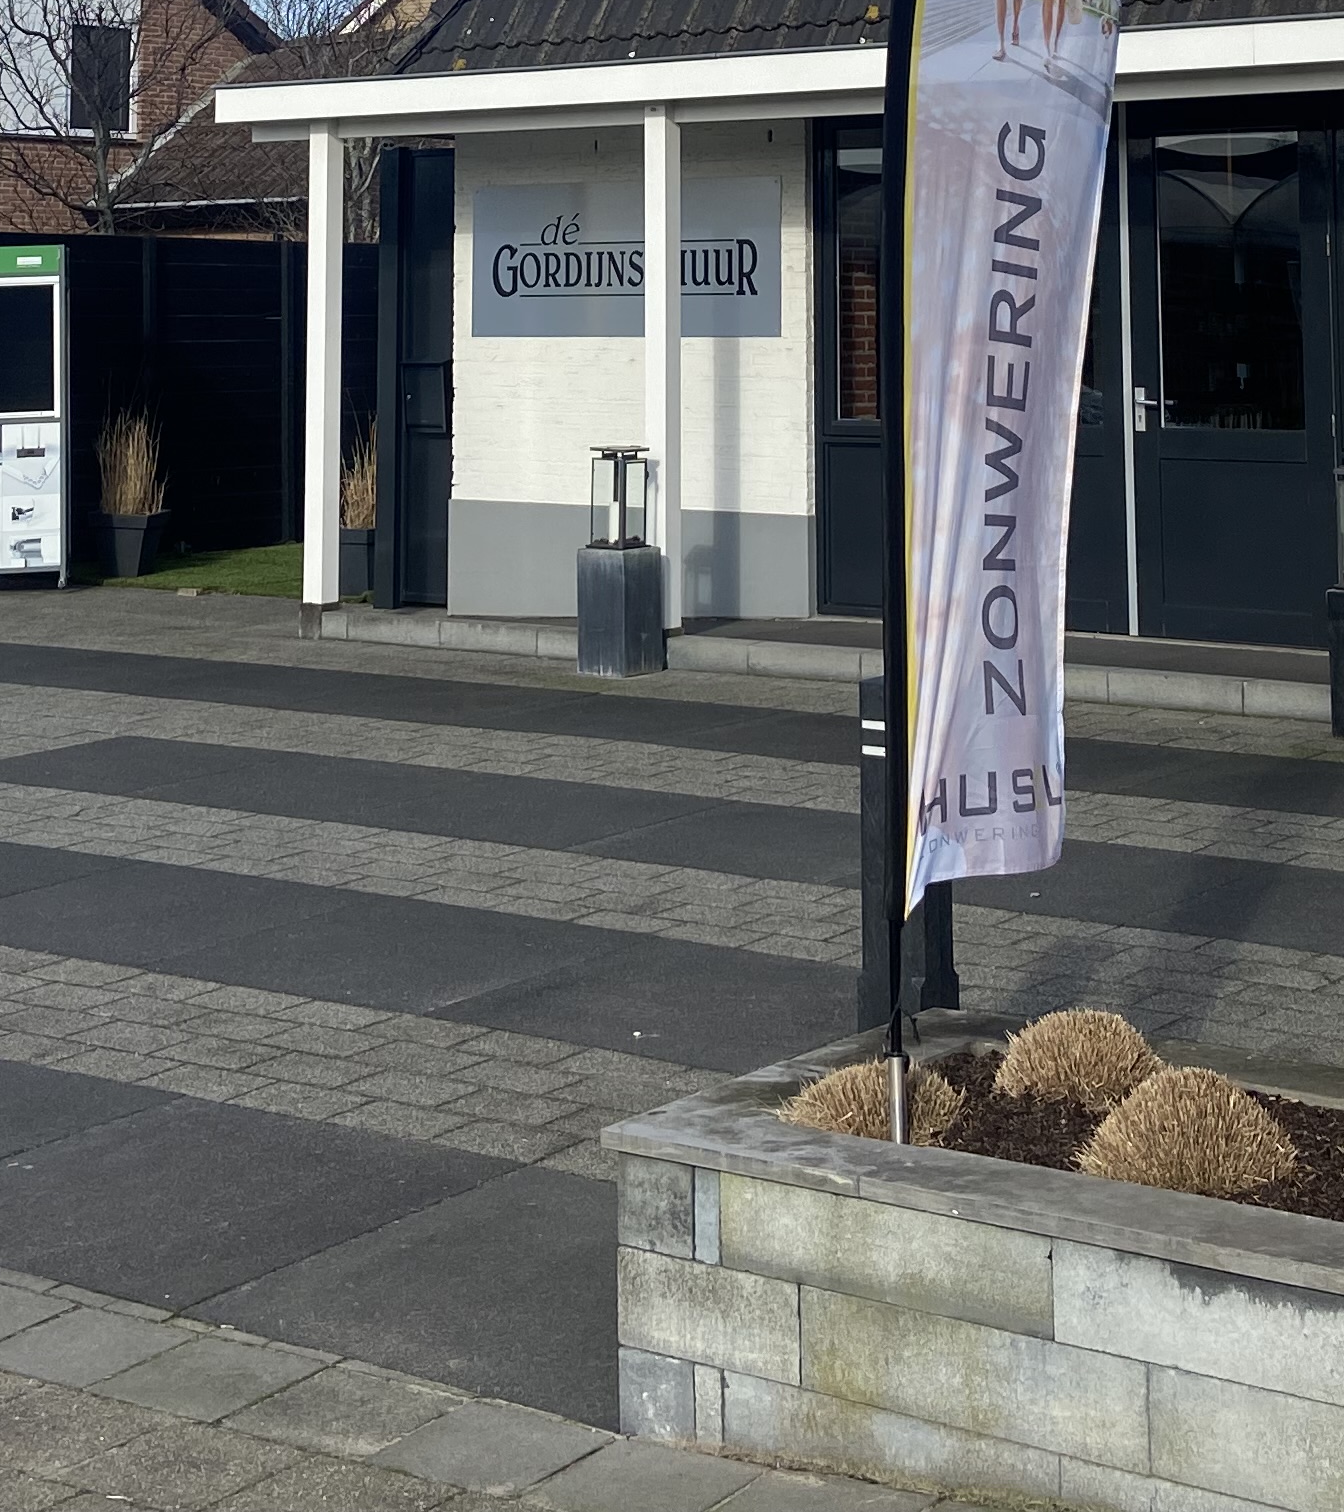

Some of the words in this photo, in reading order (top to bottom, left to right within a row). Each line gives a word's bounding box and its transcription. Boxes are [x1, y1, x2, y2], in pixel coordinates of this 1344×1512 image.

[540, 212, 580, 246] dé
[492, 239, 758, 297] GORDIJNSUUR
[981, 121, 1046, 716] ZONWERING
[920, 823, 1040, 862] ONWERING
